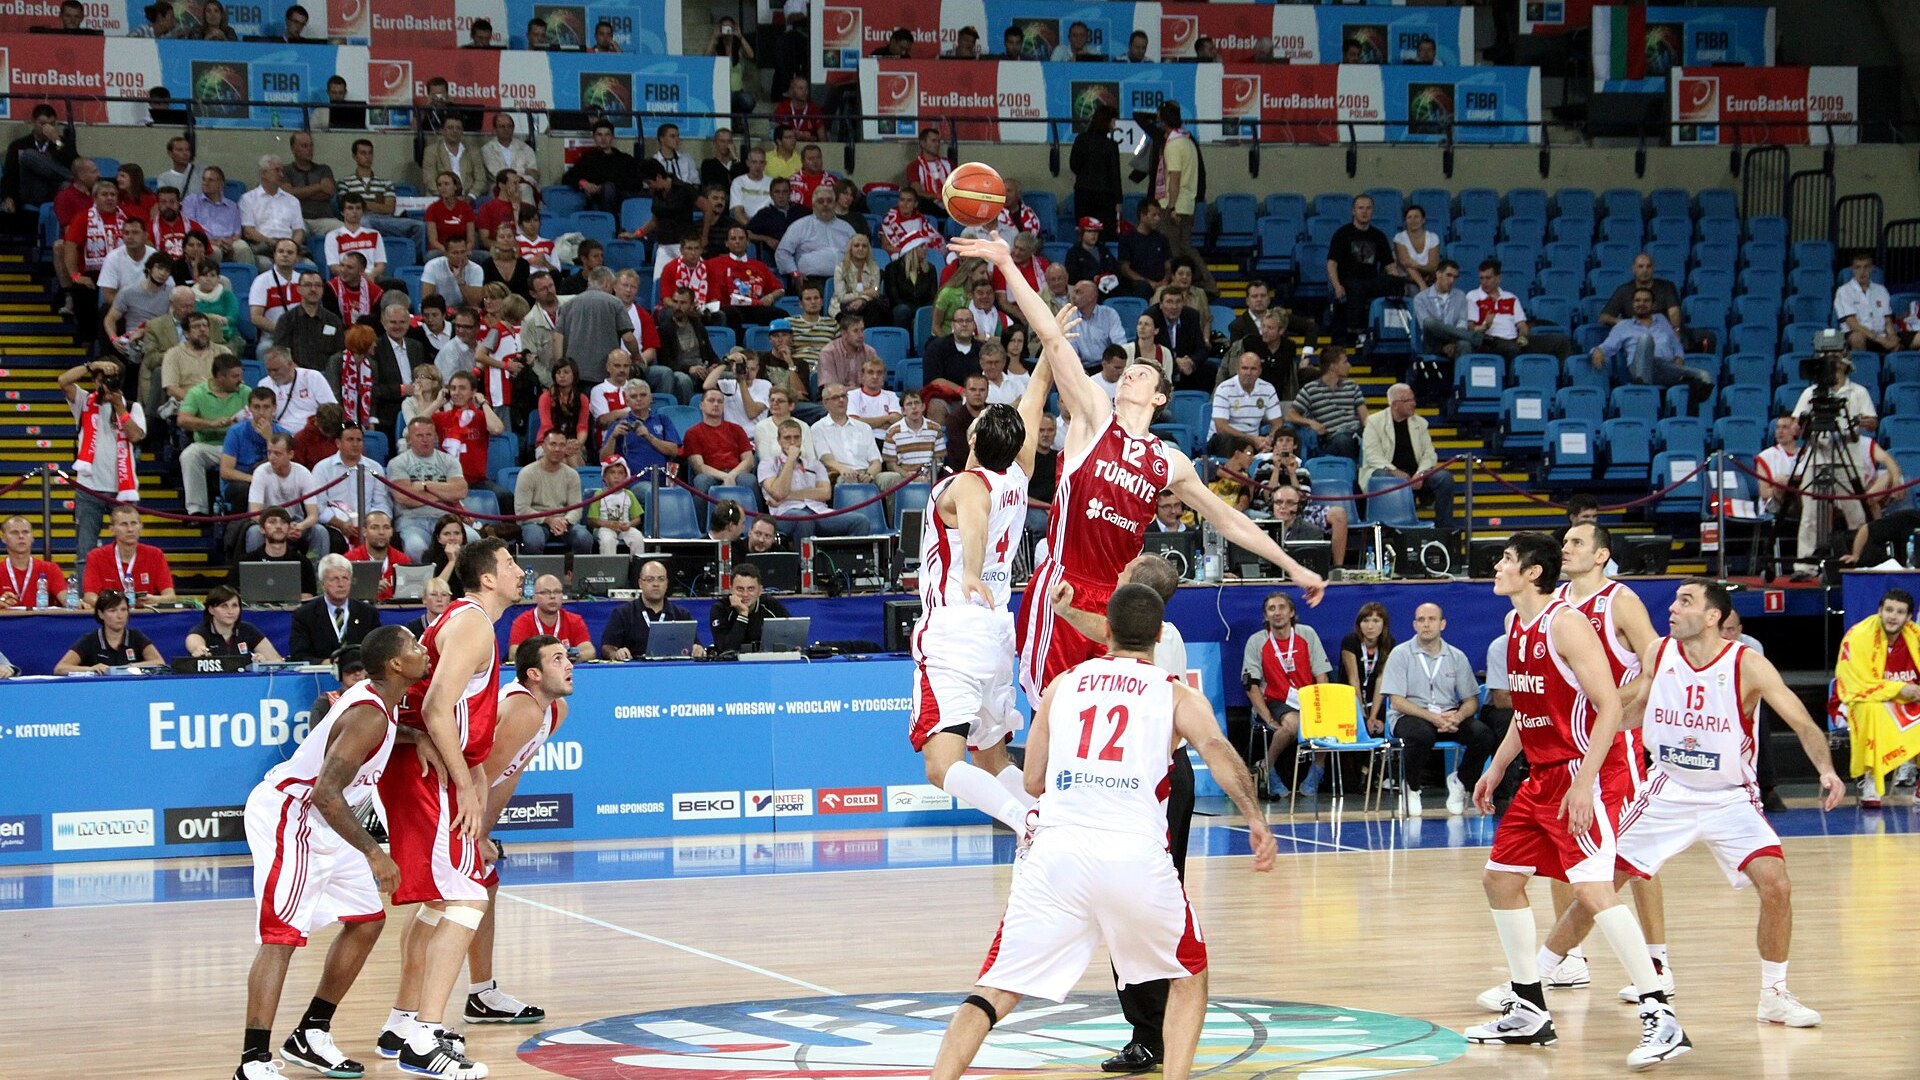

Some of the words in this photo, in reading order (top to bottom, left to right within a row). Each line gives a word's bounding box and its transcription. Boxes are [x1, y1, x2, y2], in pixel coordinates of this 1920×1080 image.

[0, 0, 61, 17] roBaske
[83, 3, 109, 18] 009
[226, 5, 262, 23] FIBA
[86, 19, 120, 29] POLAND
[373, 14, 453, 31] EuroBasket
[1274, 35, 1305, 49] 2009
[1695, 32, 1729, 49] FIBA
[12, 68, 101, 88] EuroBasket
[106, 71, 144, 88] 2009
[262, 72, 300, 90] FIBA
[120, 88, 151, 98] POLAN
[415, 80, 497, 98] EuBasket
[501, 84, 536, 98] 2009
[645, 84, 680, 101] FIBA
[513, 99, 546, 109] POLAND
[646, 102, 678, 112] EUROPE
[920, 91, 994, 107] EuroBasket
[998, 93, 1031, 107] 2009
[1132, 90, 1164, 107] FIBA
[1262, 94, 1334, 109] EuroBasket
[1338, 94, 1369, 109] 2009
[1465, 92, 1497, 109] FIBA
[1726, 95, 1804, 112] EuroBasket
[1809, 95, 1844, 111] 2009
[1010, 108, 1040, 118] POLAND
[1349, 109, 1378, 119] POLAND
[1467, 109, 1496, 119] EUROPE
[1111, 128, 1134, 145] C1
[1121, 437, 1147, 468] 12
[1094, 459, 1156, 504] TÜRKİYE
[996, 526, 1009, 563] 4
[1518, 635, 1527, 662] 8
[1077, 674, 1148, 696] EVTIMOV
[1686, 684, 1705, 711] 15
[614, 706, 660, 719] GDANSK
[670, 703, 715, 717] POZNAN
[725, 702, 776, 715] WARSAW
[786, 700, 841, 713] WROCLAW
[149, 698, 311, 750] EuroBa
[1655, 707, 1731, 733] BULGARIA
[15, 723, 80, 738] KATOWICE
[1076, 704, 1129, 762] 12
[524, 741, 583, 771] AND
[1661, 747, 1717, 769] Jedenika
[1074, 772, 1140, 790] EUROINS
[678, 799, 735, 812] BEKO
[775, 794, 804, 804] INTER
[776, 803, 804, 812] SPORT
[846, 795, 876, 805] ORLEN
[510, 801, 559, 822] zepter
[597, 804, 618, 815] MAIN
[620, 802, 664, 814] SPONSORS
[0, 821, 25, 837] en
[77, 820, 148, 836] MONDO
[178, 811, 219, 839] ovi
